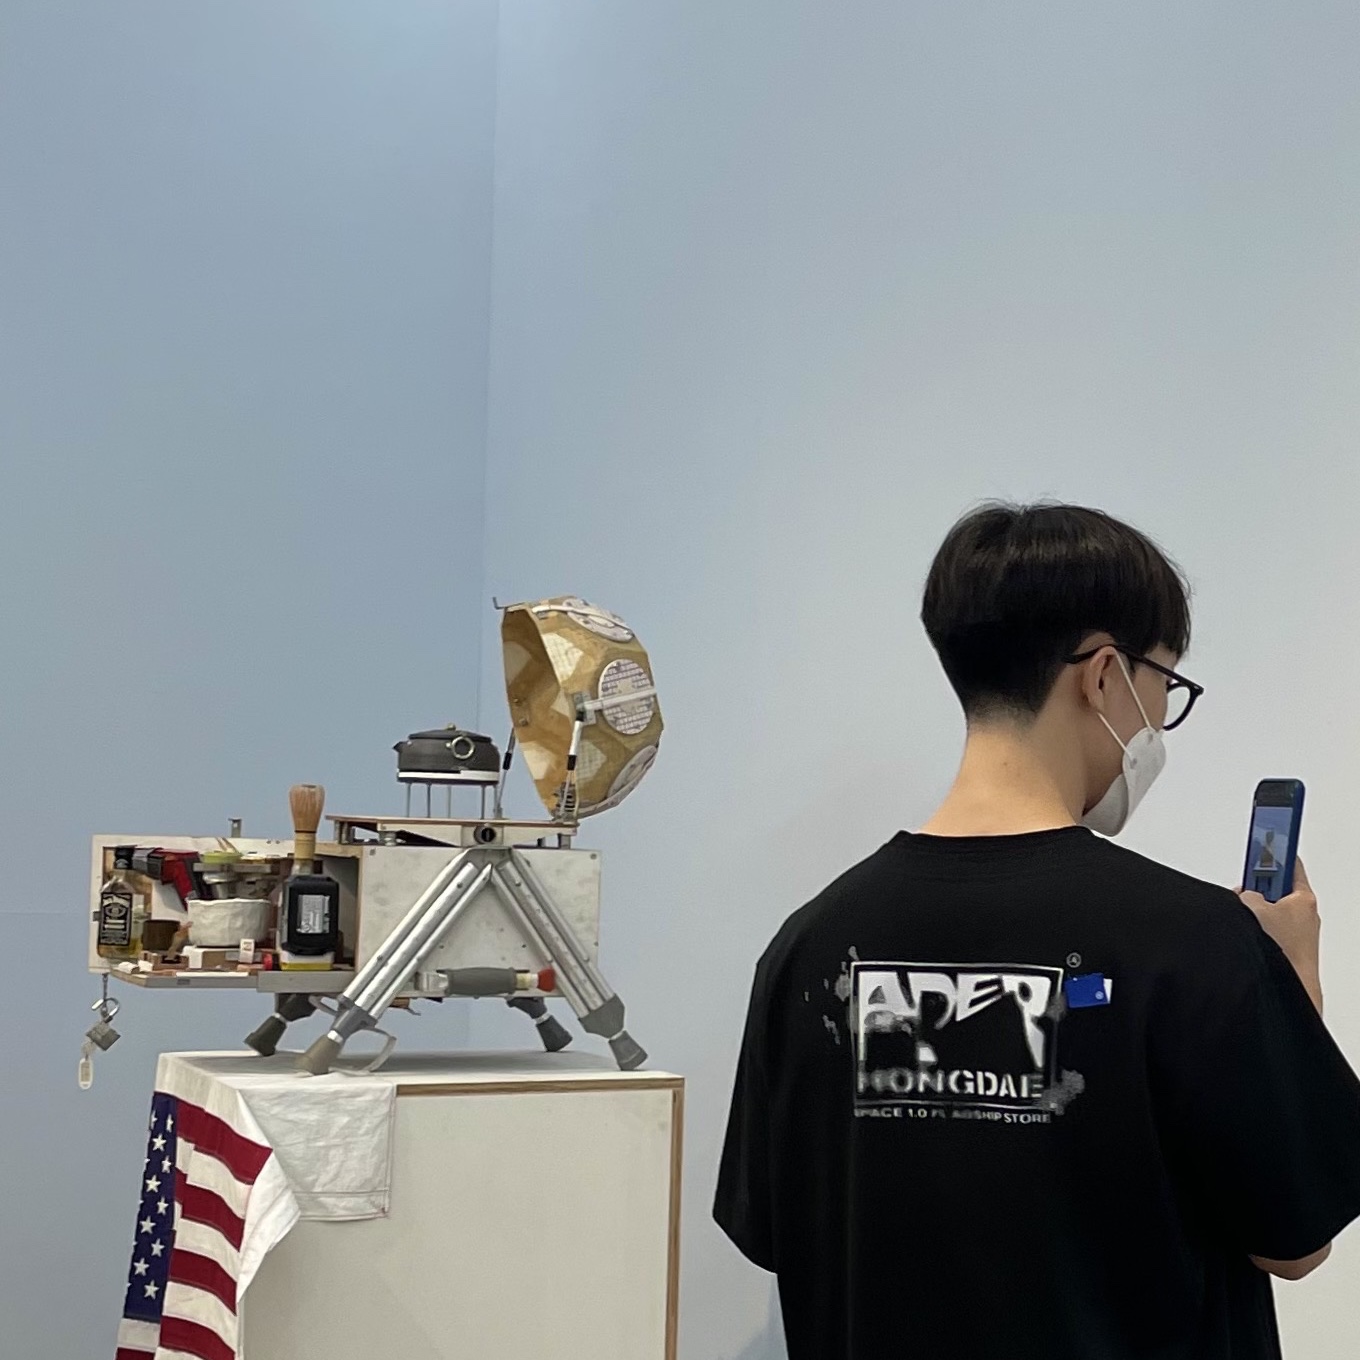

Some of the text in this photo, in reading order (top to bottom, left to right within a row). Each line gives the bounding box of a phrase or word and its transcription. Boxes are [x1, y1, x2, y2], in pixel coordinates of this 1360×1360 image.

[858, 971, 1051, 1068] ADER
[857, 1068, 1044, 1099] HONGDAE
[908, 1107, 928, 1118] 1.0
[1003, 1112, 1051, 1124] STORE
